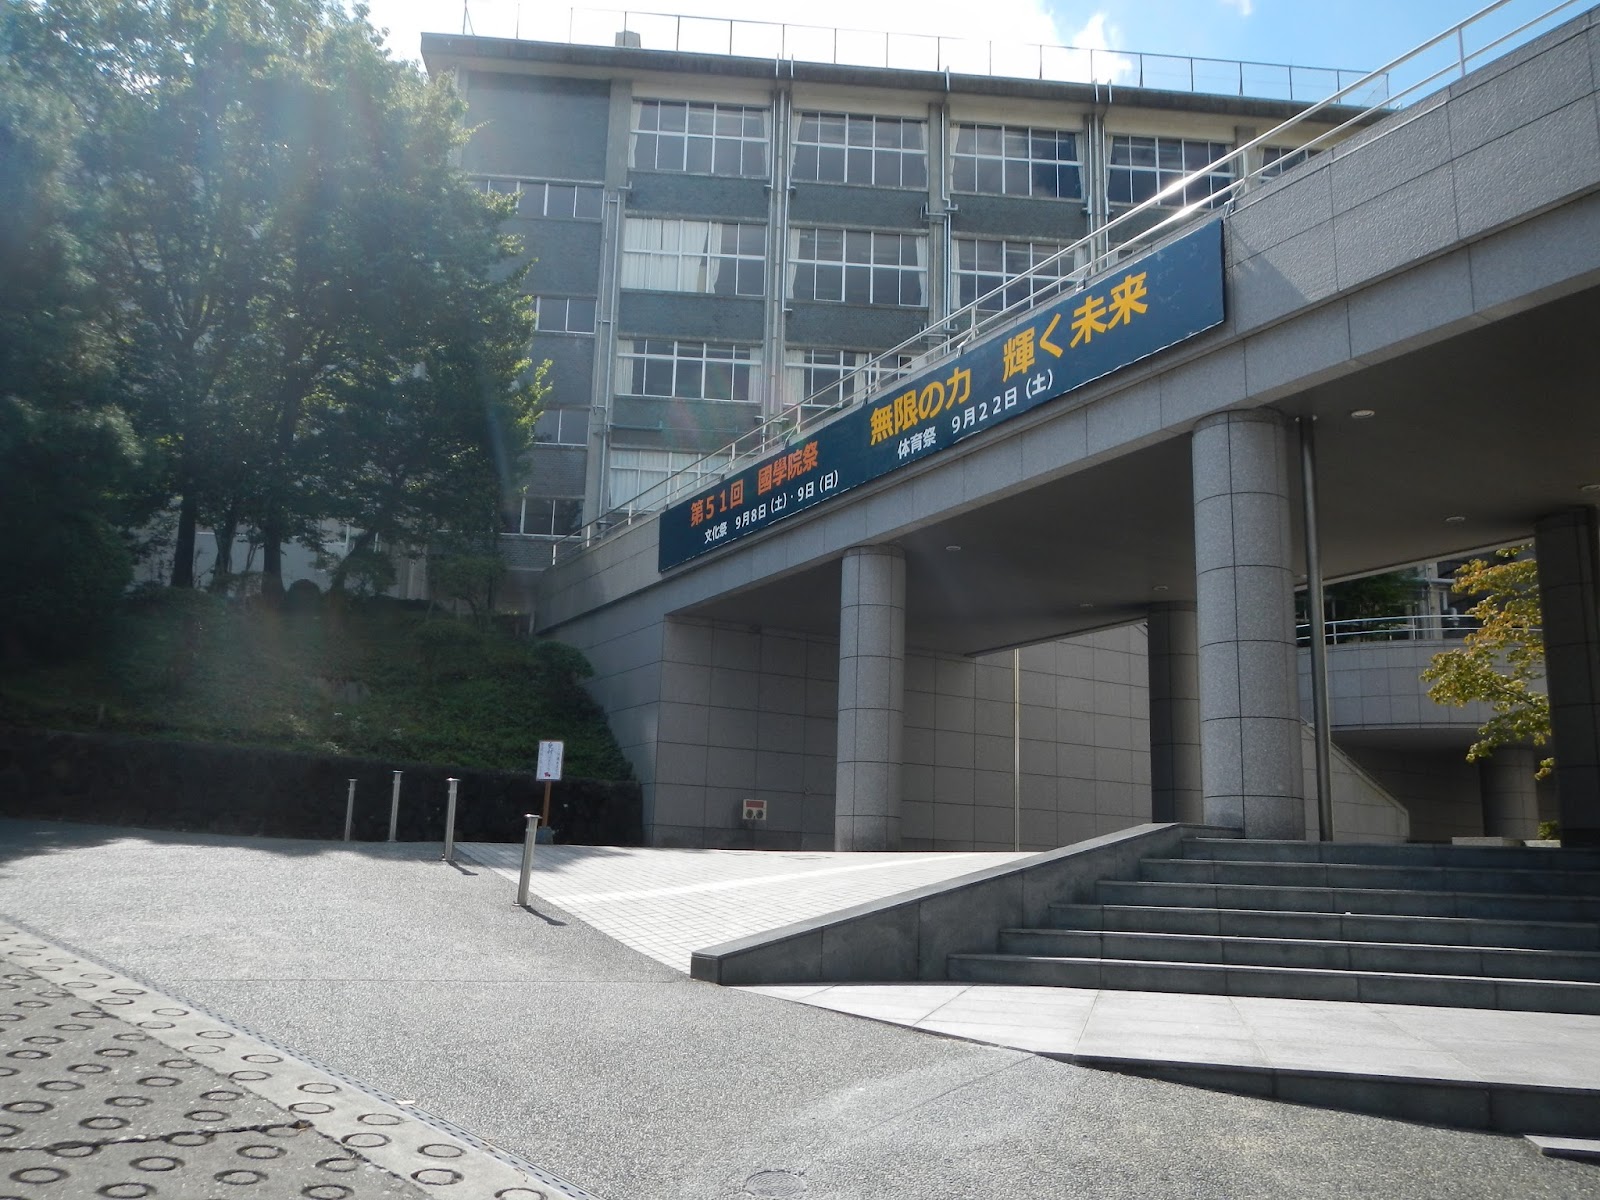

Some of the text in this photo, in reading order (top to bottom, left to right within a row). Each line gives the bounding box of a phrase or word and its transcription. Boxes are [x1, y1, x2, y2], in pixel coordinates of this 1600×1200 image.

[870, 271, 1149, 446] 無限の力 輝く未来
[897, 424, 937, 460] 体育祭
[690, 440, 818, 527] 第51回 國學院祭
[704, 521, 728, 545] 文化祭
